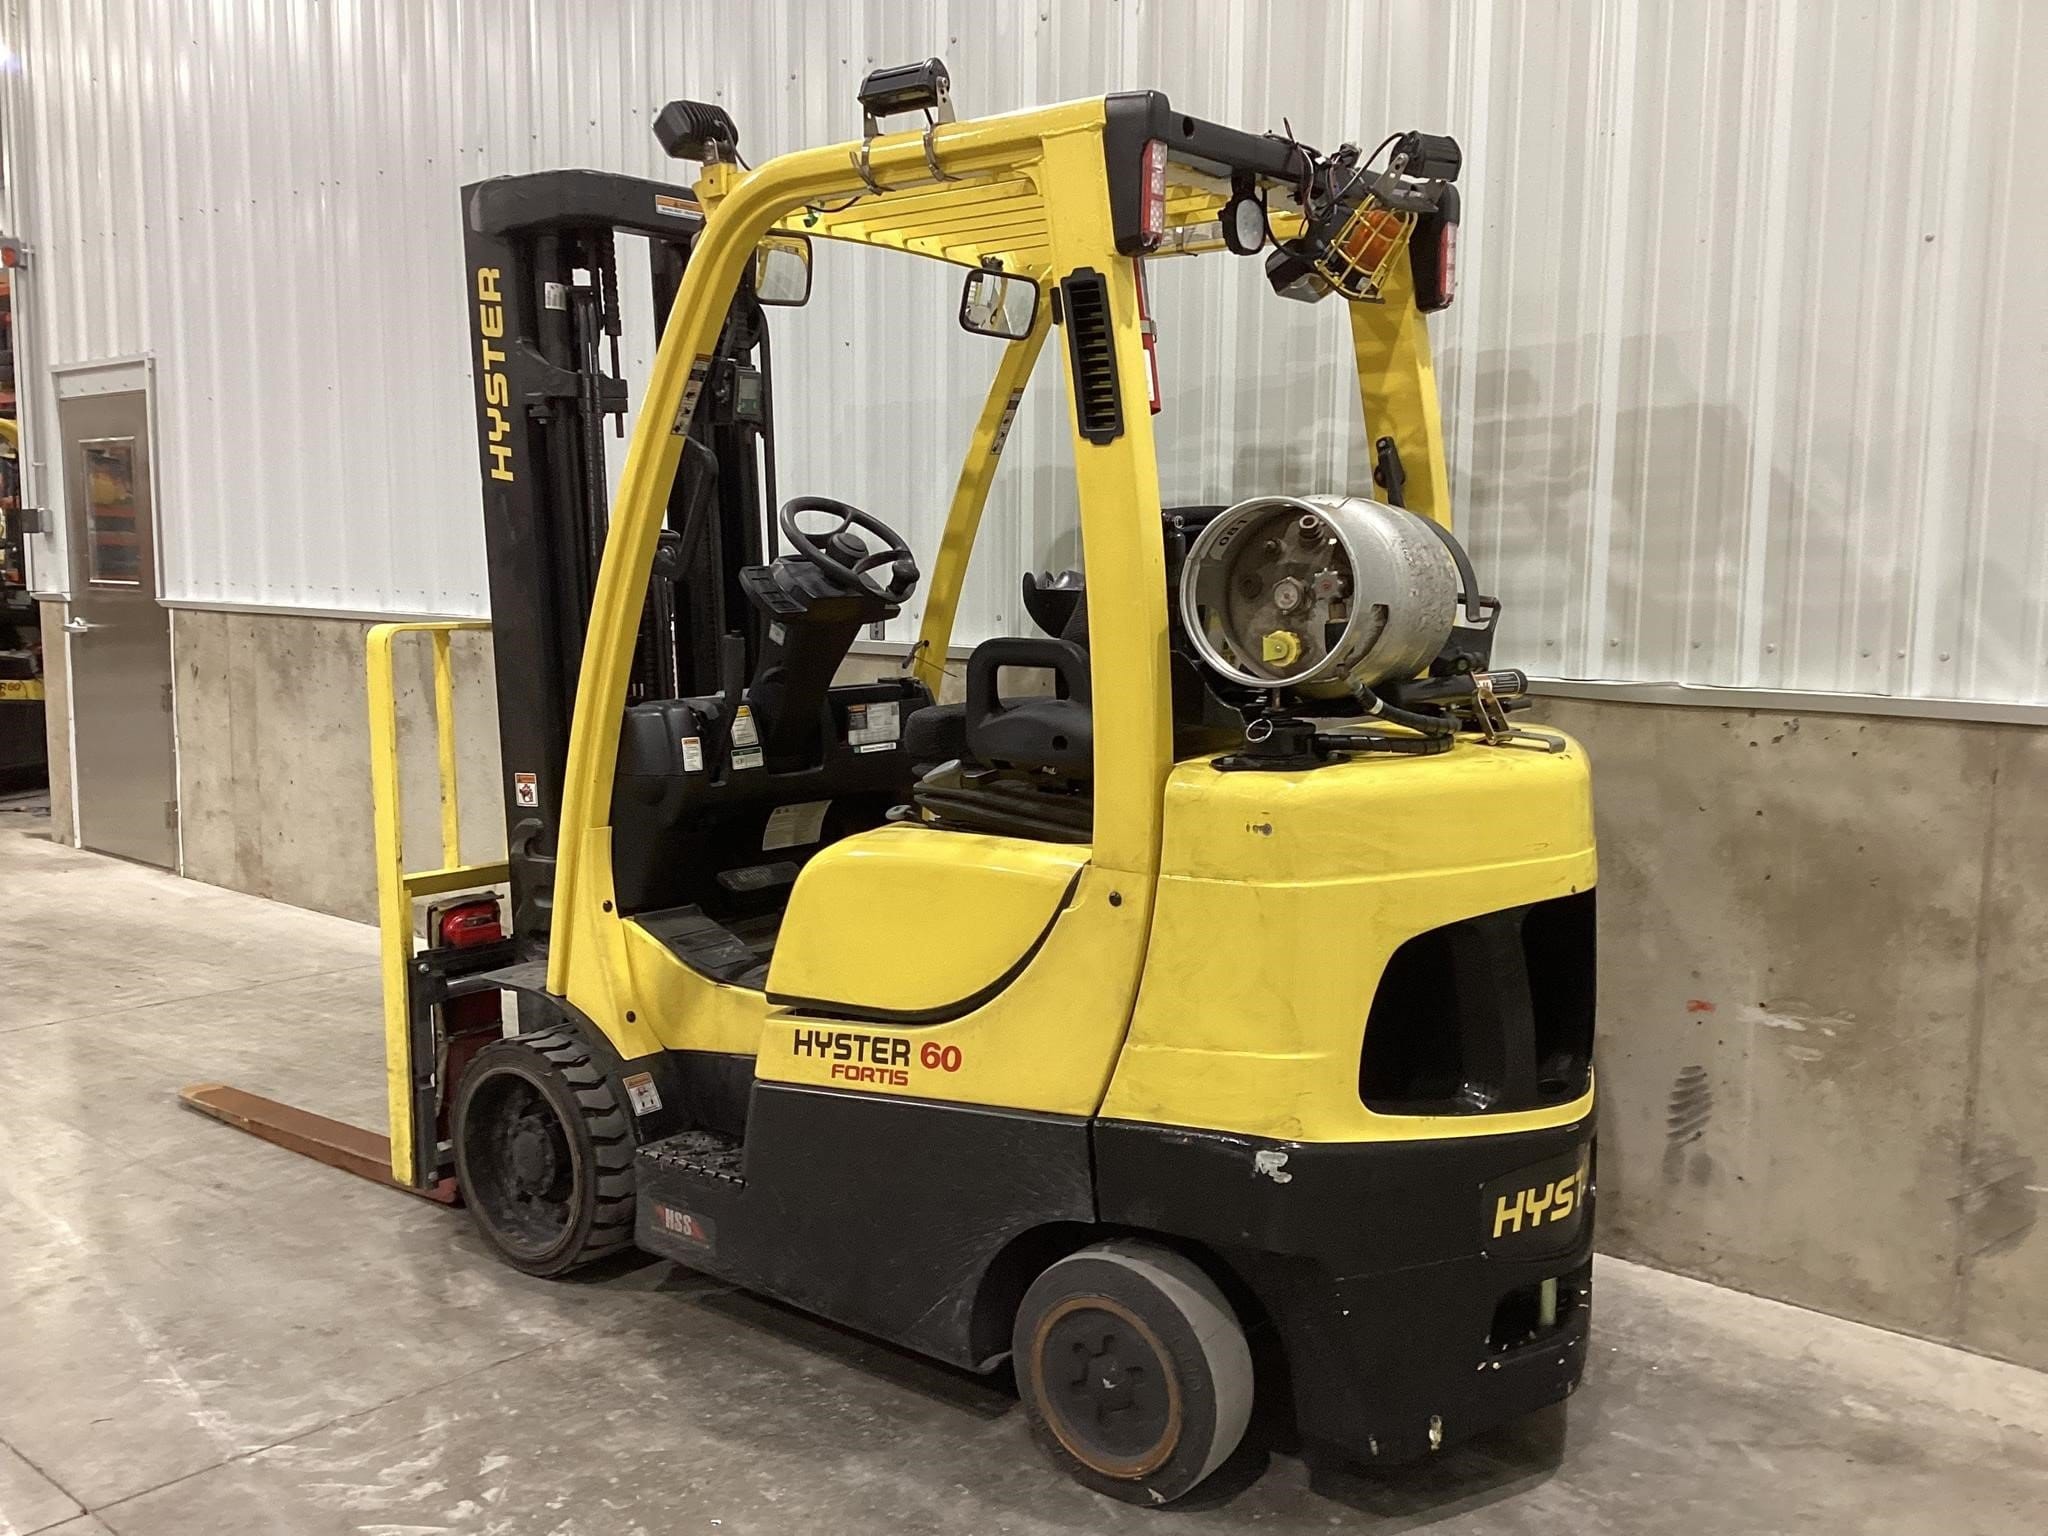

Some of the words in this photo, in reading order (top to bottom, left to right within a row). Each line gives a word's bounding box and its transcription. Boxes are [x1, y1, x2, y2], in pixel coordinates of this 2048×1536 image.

[477, 267, 514, 482] HYSTER
[793, 1029, 911, 1067] HYSTER
[920, 1041, 962, 1072] 60
[831, 1063, 909, 1086] FORTIS
[665, 1207, 692, 1236] HSS
